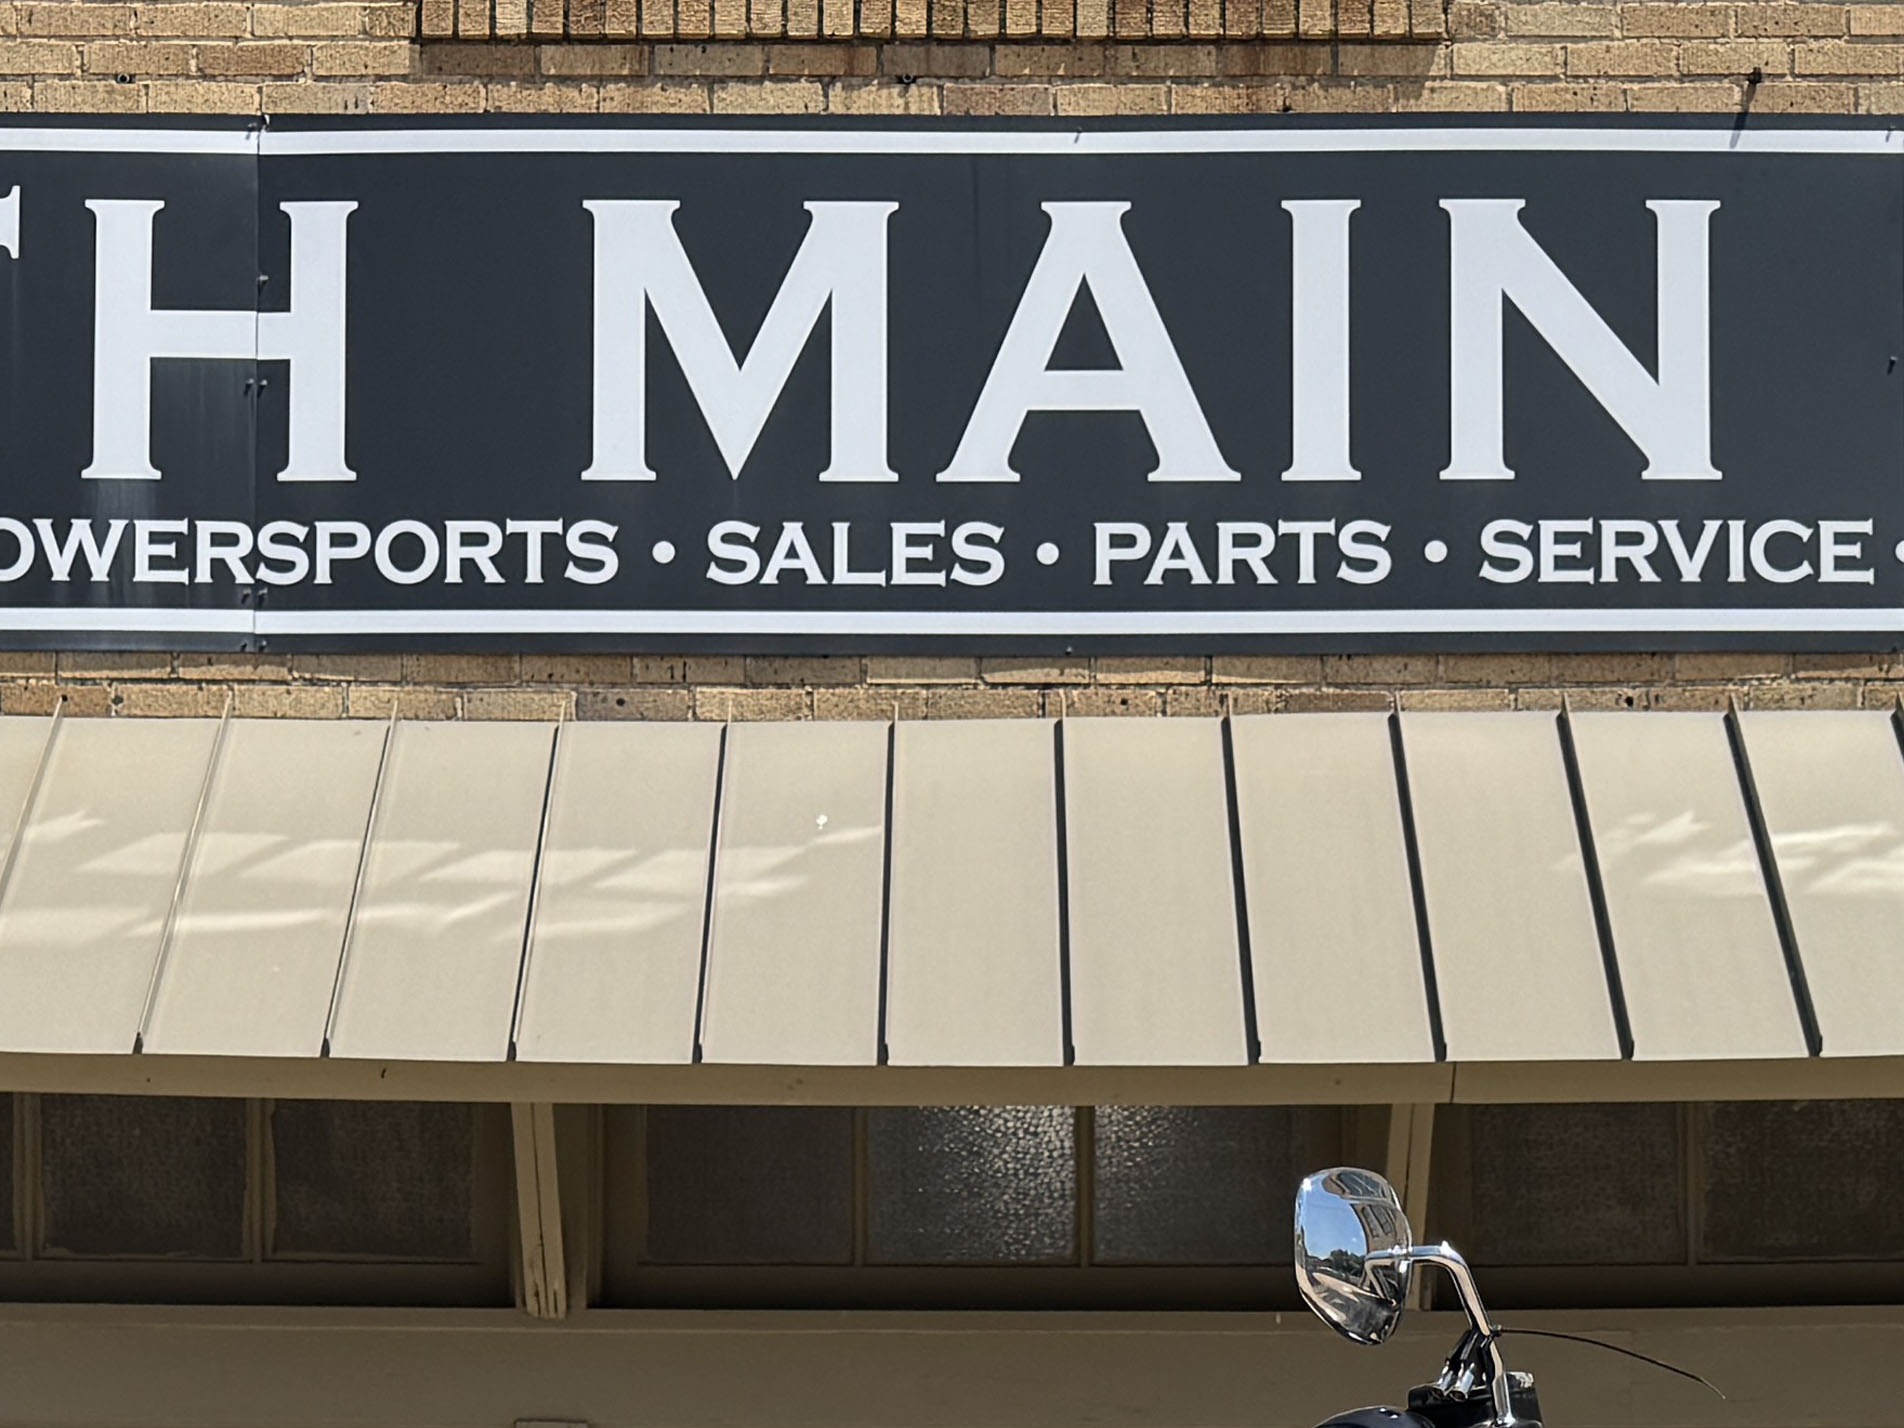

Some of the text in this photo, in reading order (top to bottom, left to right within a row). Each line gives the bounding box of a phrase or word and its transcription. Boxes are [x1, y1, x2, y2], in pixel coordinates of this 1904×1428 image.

[581, 198, 1722, 483] MAIN
[706, 518, 1005, 587] SALES
[1093, 518, 1392, 586] PARTS
[1479, 517, 1875, 585] SERVICE
